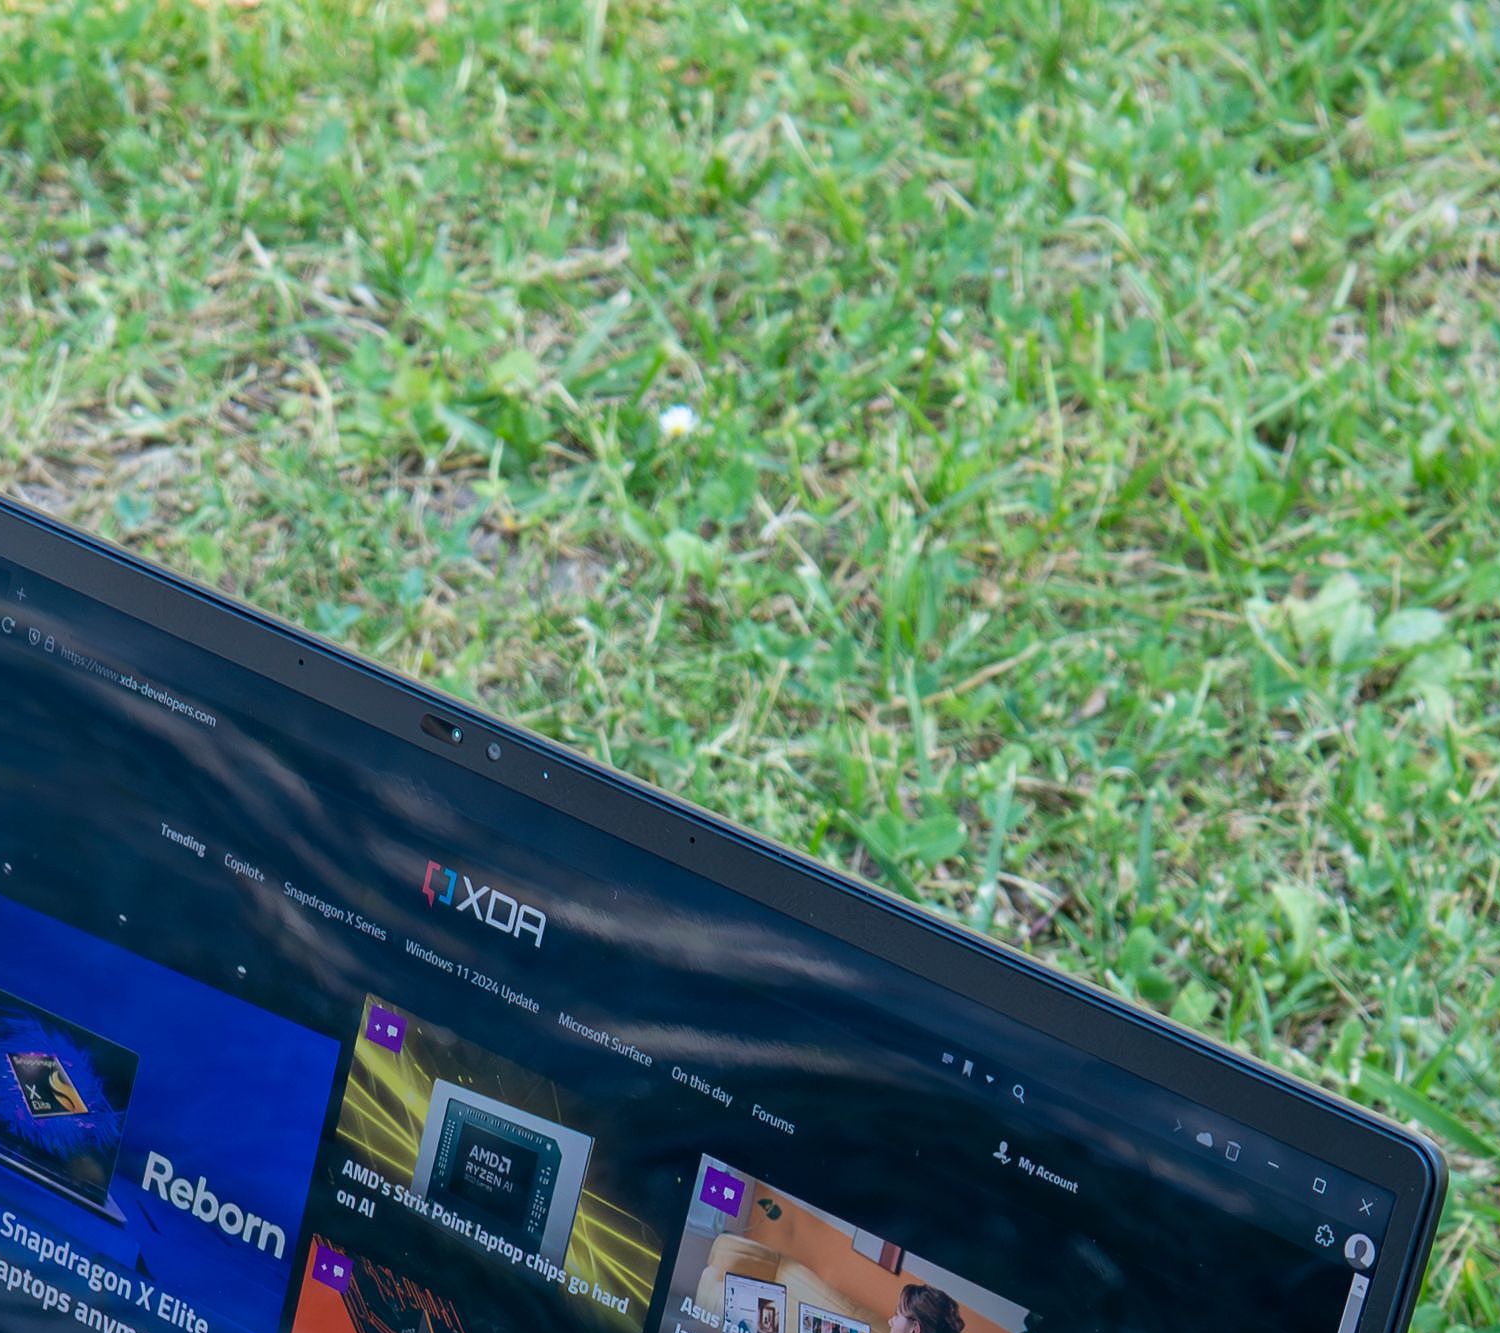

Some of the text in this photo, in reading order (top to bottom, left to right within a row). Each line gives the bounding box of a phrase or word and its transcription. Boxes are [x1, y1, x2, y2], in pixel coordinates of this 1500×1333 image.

[161, 821, 207, 858] Trending
[223, 852, 265, 882] Copilot+
[283, 881, 387, 941] Snapdragon X Series
[455, 875, 547, 948] XDA
[405, 938, 540, 1014] Windows 11 2024 Update
[557, 1011, 653, 1067] Microsoft Surface
[671, 1065, 733, 1108] On this day
[751, 1103, 795, 1135] Forums
[464, 1160, 502, 1188] RYZEN
[502, 1180, 513, 1193] AI
[468, 1144, 500, 1168] AMD
[1017, 1155, 1079, 1194] My Account
[141, 1150, 286, 1260] Reborn
[336, 1189, 376, 1218] on AI
[341, 1159, 391, 1196] AMD's
[392, 1184, 430, 1216] Strix
[430, 1202, 473, 1238] Point
[473, 1223, 523, 1265] laptop
[525, 1253, 567, 1284] chips
[567, 1276, 588, 1295] go
[591, 1287, 629, 1315] hard
[0, 1211, 132, 1300] Snapdragon
[135, 1280, 155, 1311] X
[679, 1296, 719, 1328] Asus
